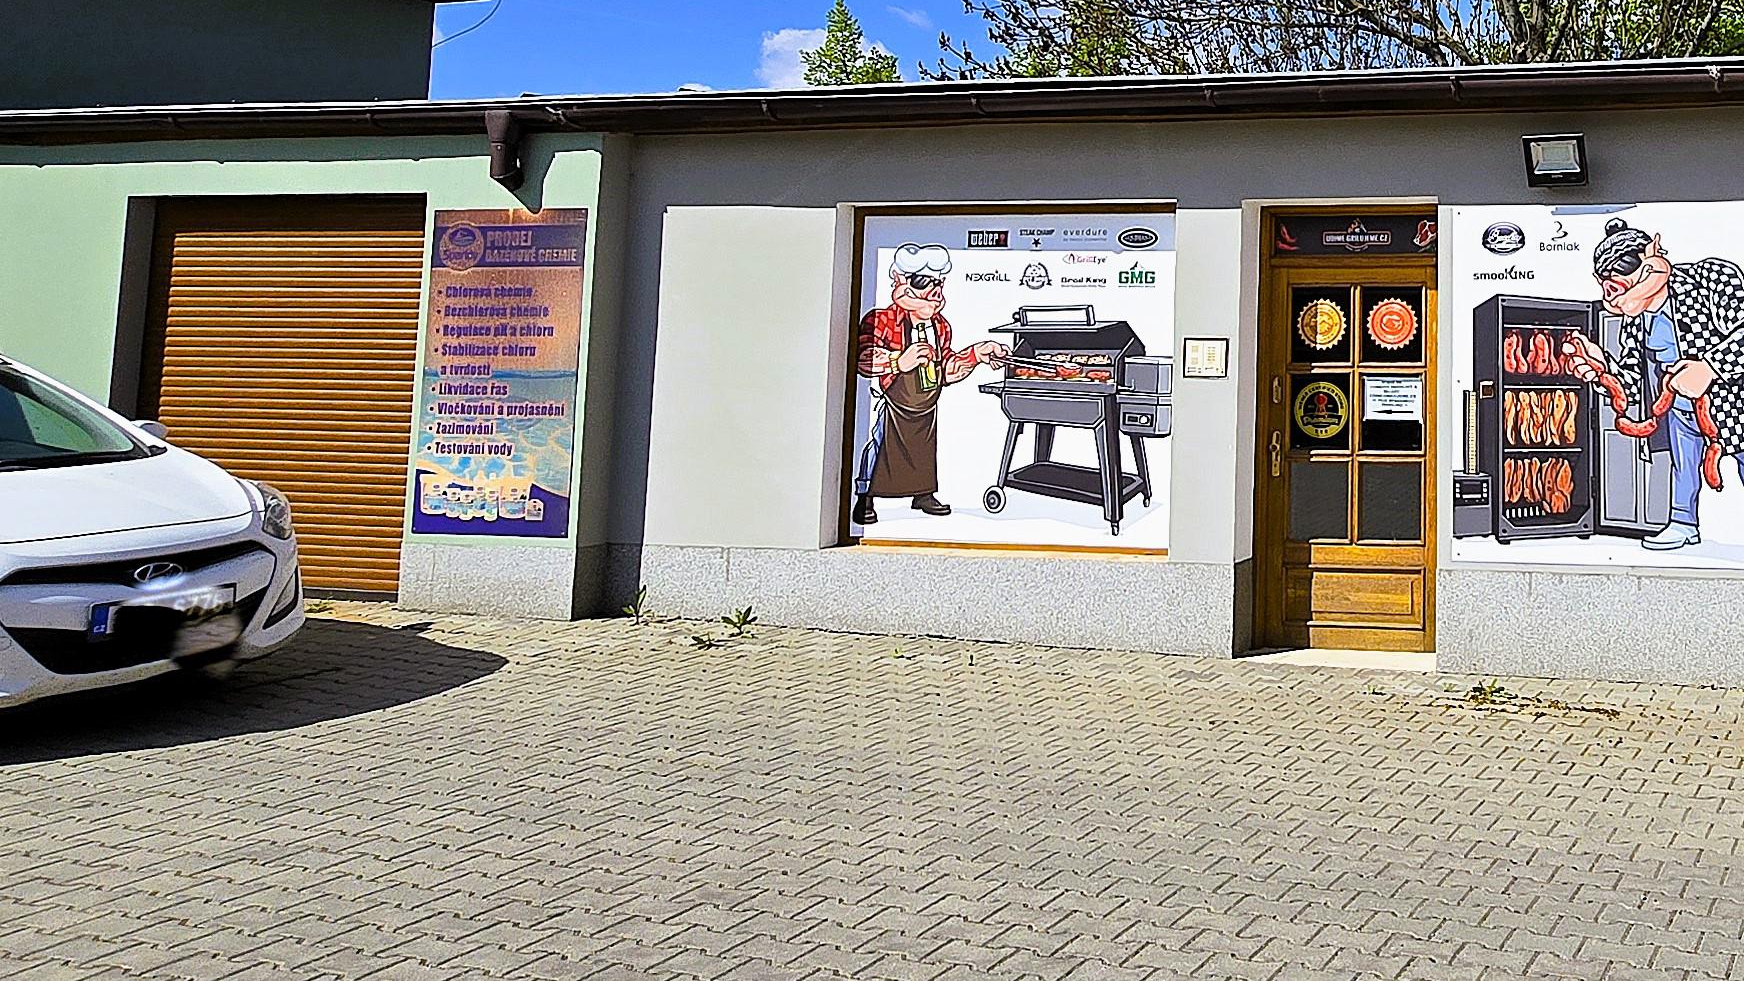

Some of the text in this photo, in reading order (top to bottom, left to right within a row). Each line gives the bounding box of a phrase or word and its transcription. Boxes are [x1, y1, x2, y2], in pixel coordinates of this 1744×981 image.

[1063, 228, 1108, 236] everdure
[1118, 271, 1156, 284] GMG
[510, 305, 550, 317] chemie
[443, 324, 492, 338] Regulace
[519, 324, 554, 337] chloru
[441, 343, 537, 357] Stabilizace chloru
[440, 363, 491, 376] a tvrdosti
[438, 382, 508, 396] Likvidace řas
[437, 402, 565, 417] Vločkování a projasnění
[435, 421, 494, 436] Zazimování
[434, 441, 513, 457] Testování vody
[93, 624, 106, 633] CZ
